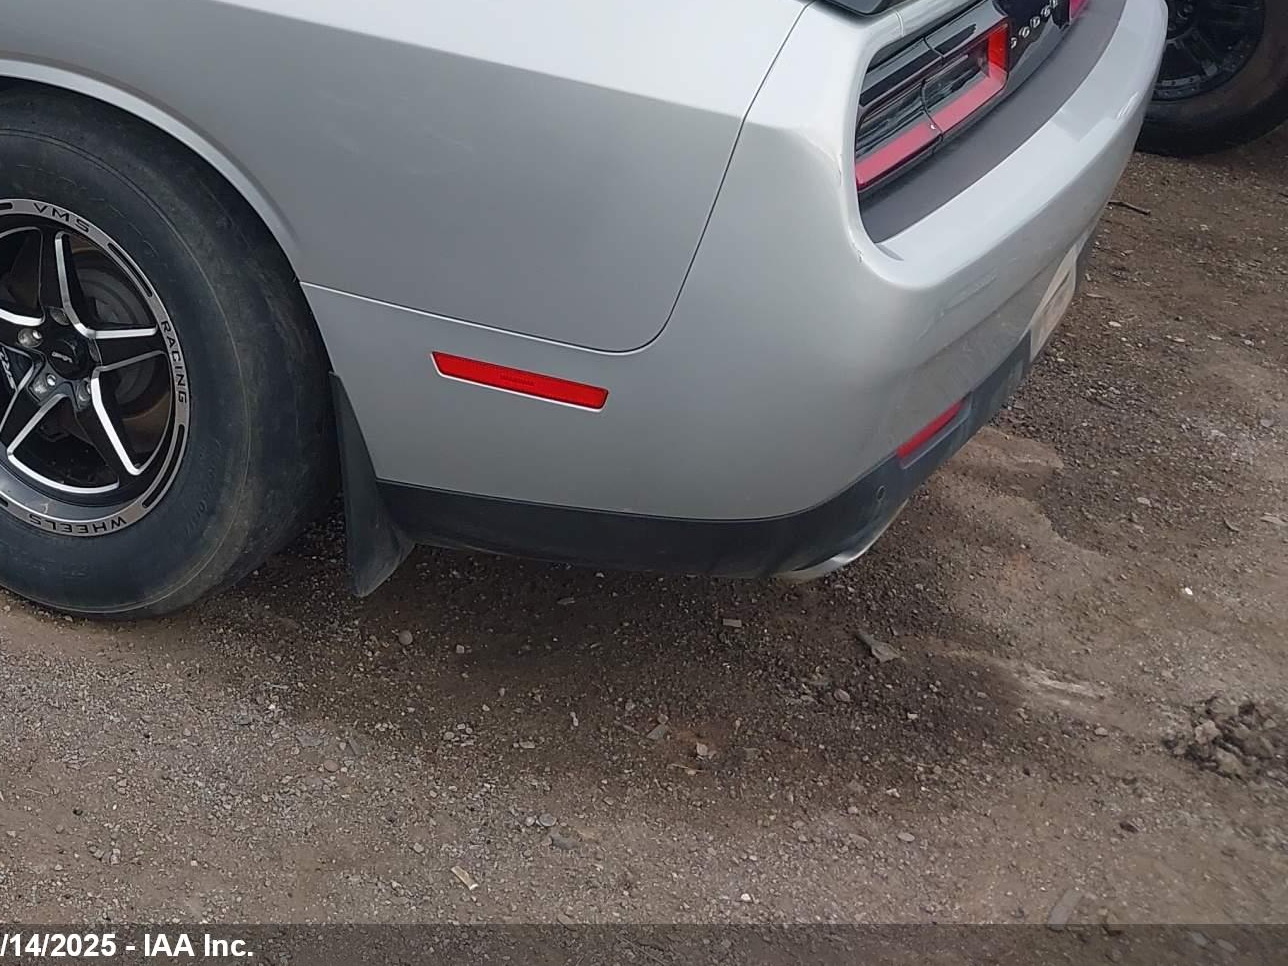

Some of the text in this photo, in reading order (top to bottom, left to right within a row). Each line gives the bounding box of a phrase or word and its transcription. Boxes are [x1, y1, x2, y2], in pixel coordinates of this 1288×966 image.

[33, 202, 90, 232] VMS
[161, 320, 188, 404] RACING
[29, 513, 126, 535] WHEELS
